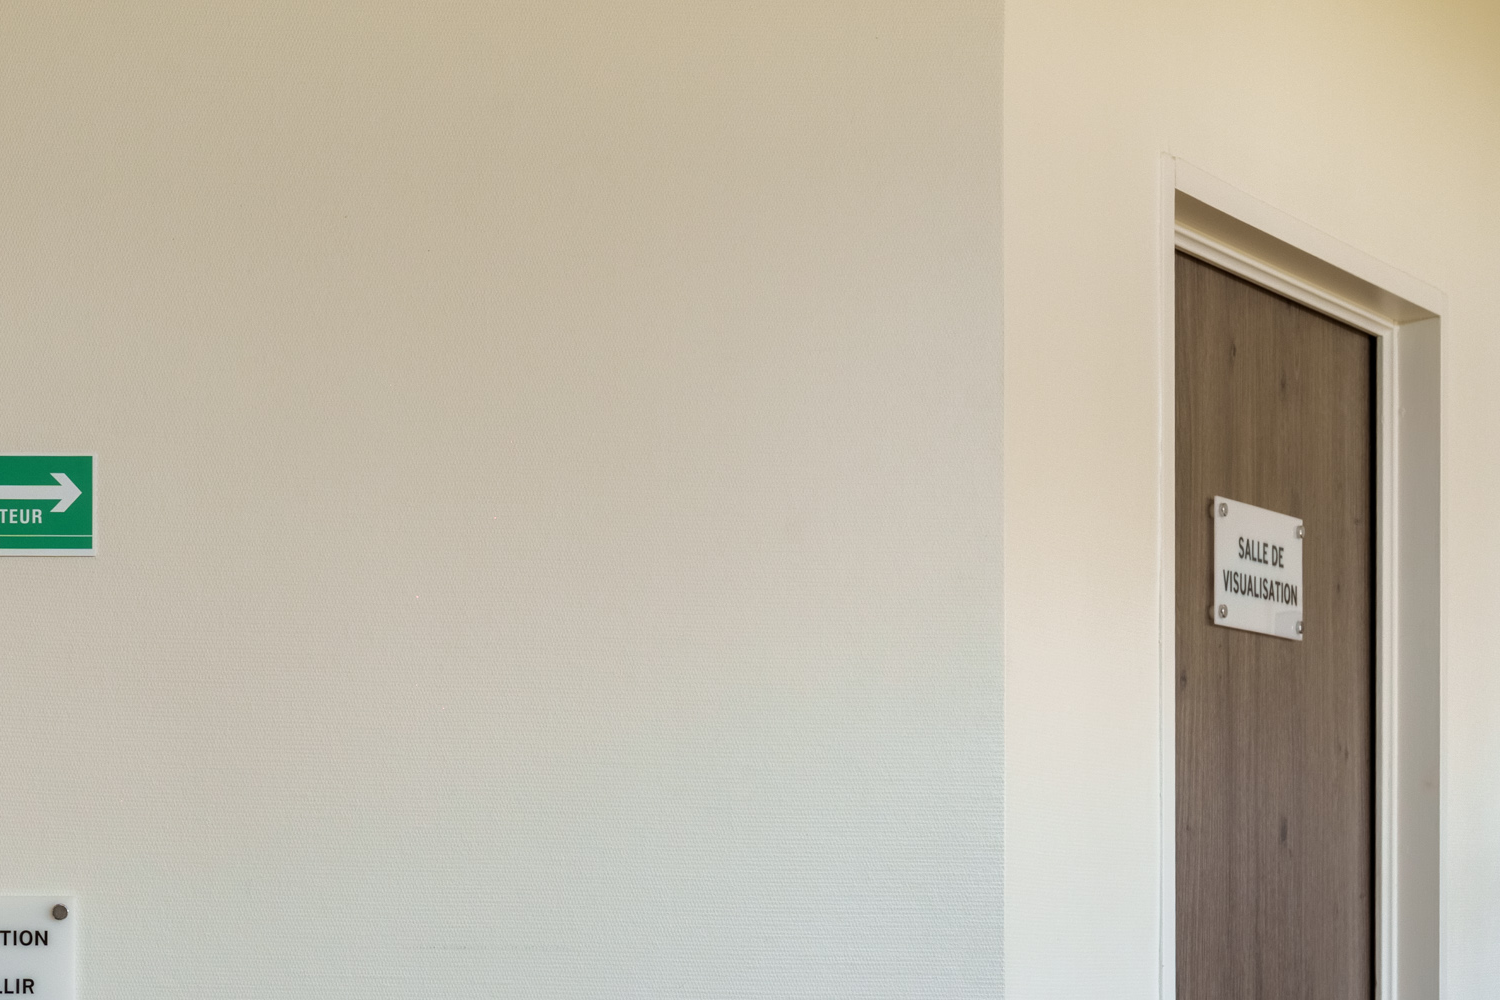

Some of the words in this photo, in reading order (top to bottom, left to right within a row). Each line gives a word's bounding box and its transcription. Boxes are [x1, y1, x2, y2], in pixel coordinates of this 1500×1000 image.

[1238, 536, 1269, 565] SALLE
[1271, 545, 1284, 568] DE
[1222, 569, 1298, 606] VISUALISATION
